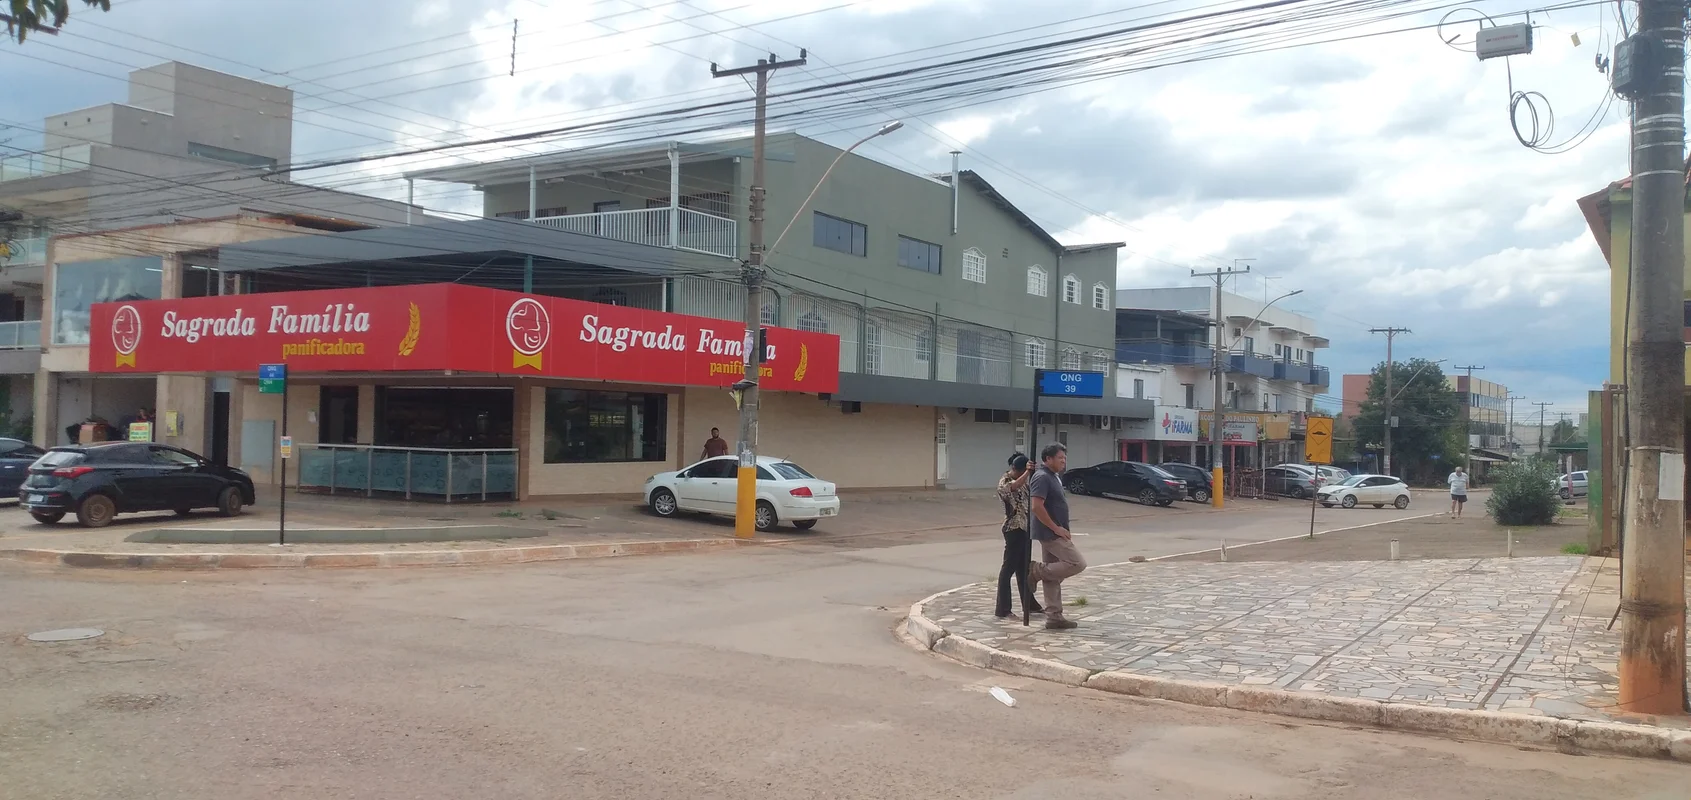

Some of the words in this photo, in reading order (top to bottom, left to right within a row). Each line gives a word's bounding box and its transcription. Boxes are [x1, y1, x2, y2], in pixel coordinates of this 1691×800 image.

[161, 309, 256, 343] Sagrada
[267, 303, 371, 333] Família
[579, 314, 685, 351] Sagrada
[696, 328, 776, 360] Fama
[282, 338, 365, 359] panificadora
[709, 361, 773, 377] panificora
[1060, 373, 1082, 382] QNG
[1064, 385, 1076, 393] 39
